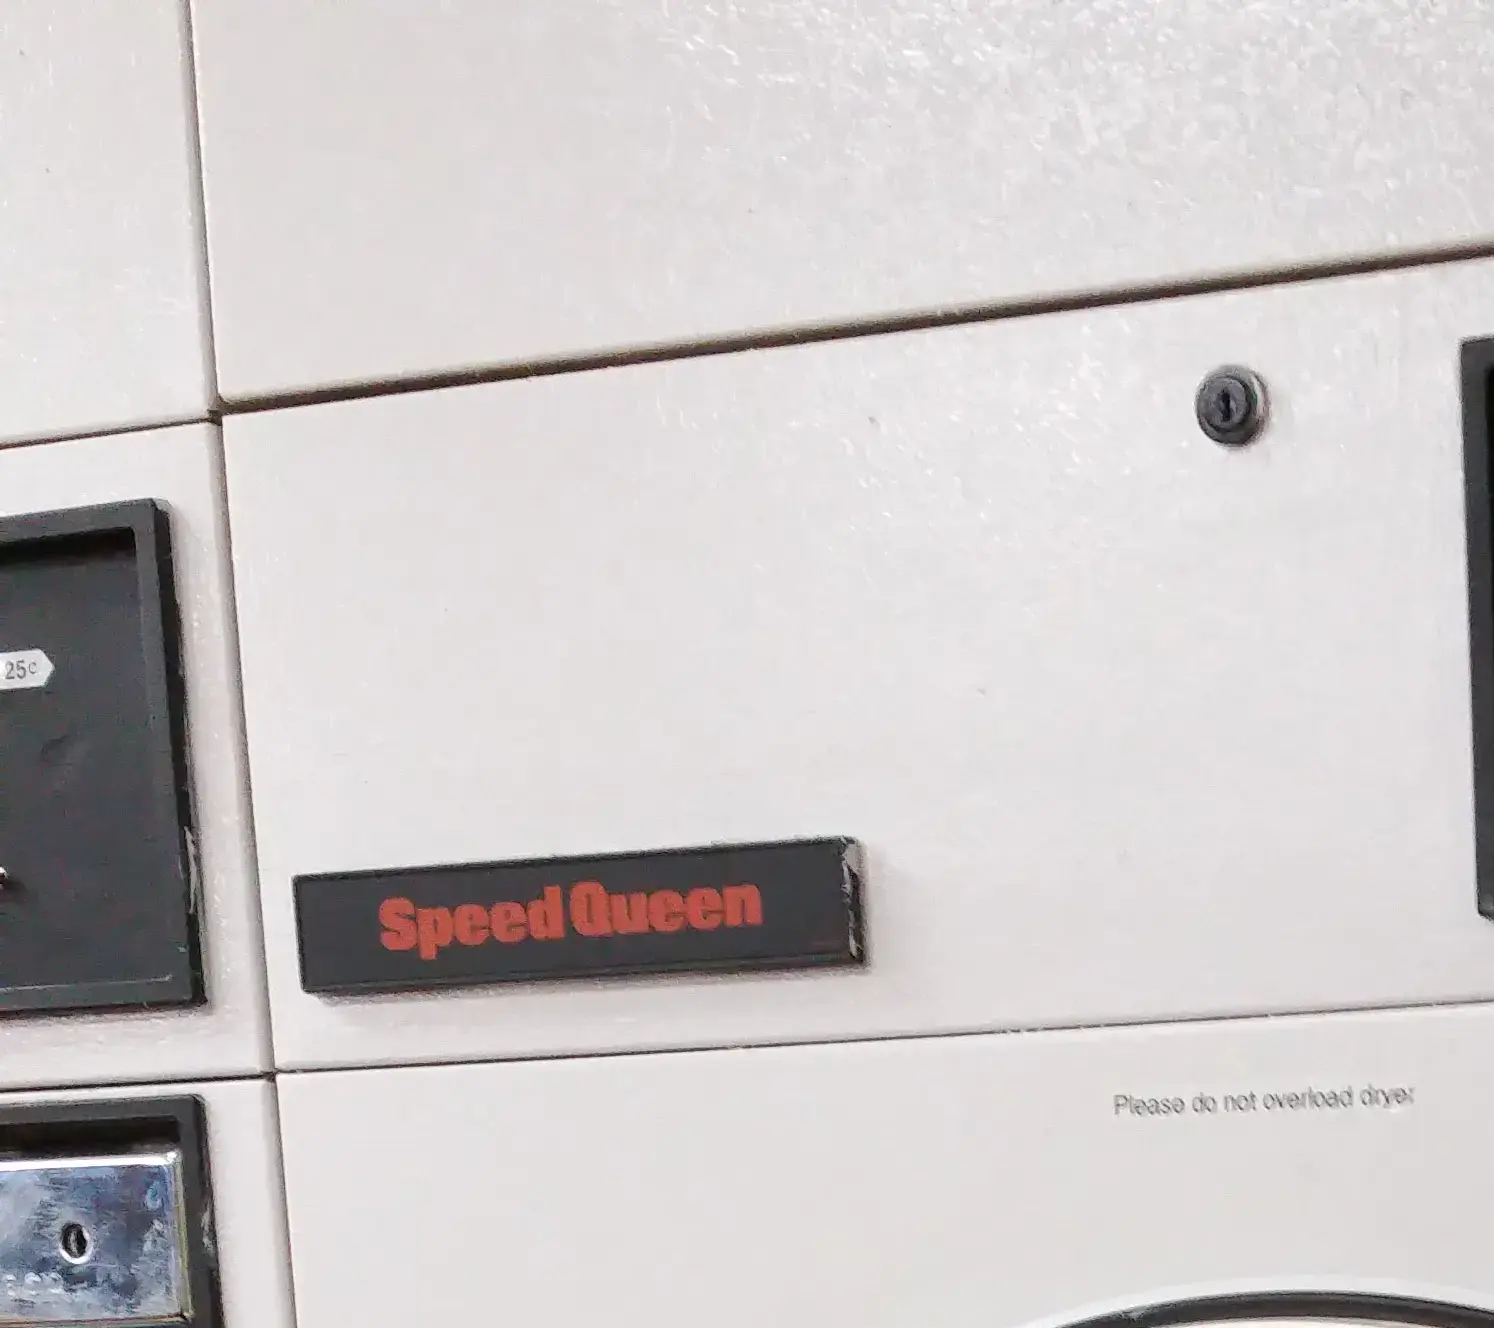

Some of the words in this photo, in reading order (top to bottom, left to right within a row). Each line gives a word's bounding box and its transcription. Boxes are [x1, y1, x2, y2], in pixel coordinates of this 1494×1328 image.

[377, 885, 564, 960] Speed
[569, 881, 763, 937] Queen
[1113, 1093, 1186, 1116] Please
[1191, 1091, 1218, 1113] do
[1223, 1090, 1258, 1112] not
[1262, 1085, 1354, 1110] overload
